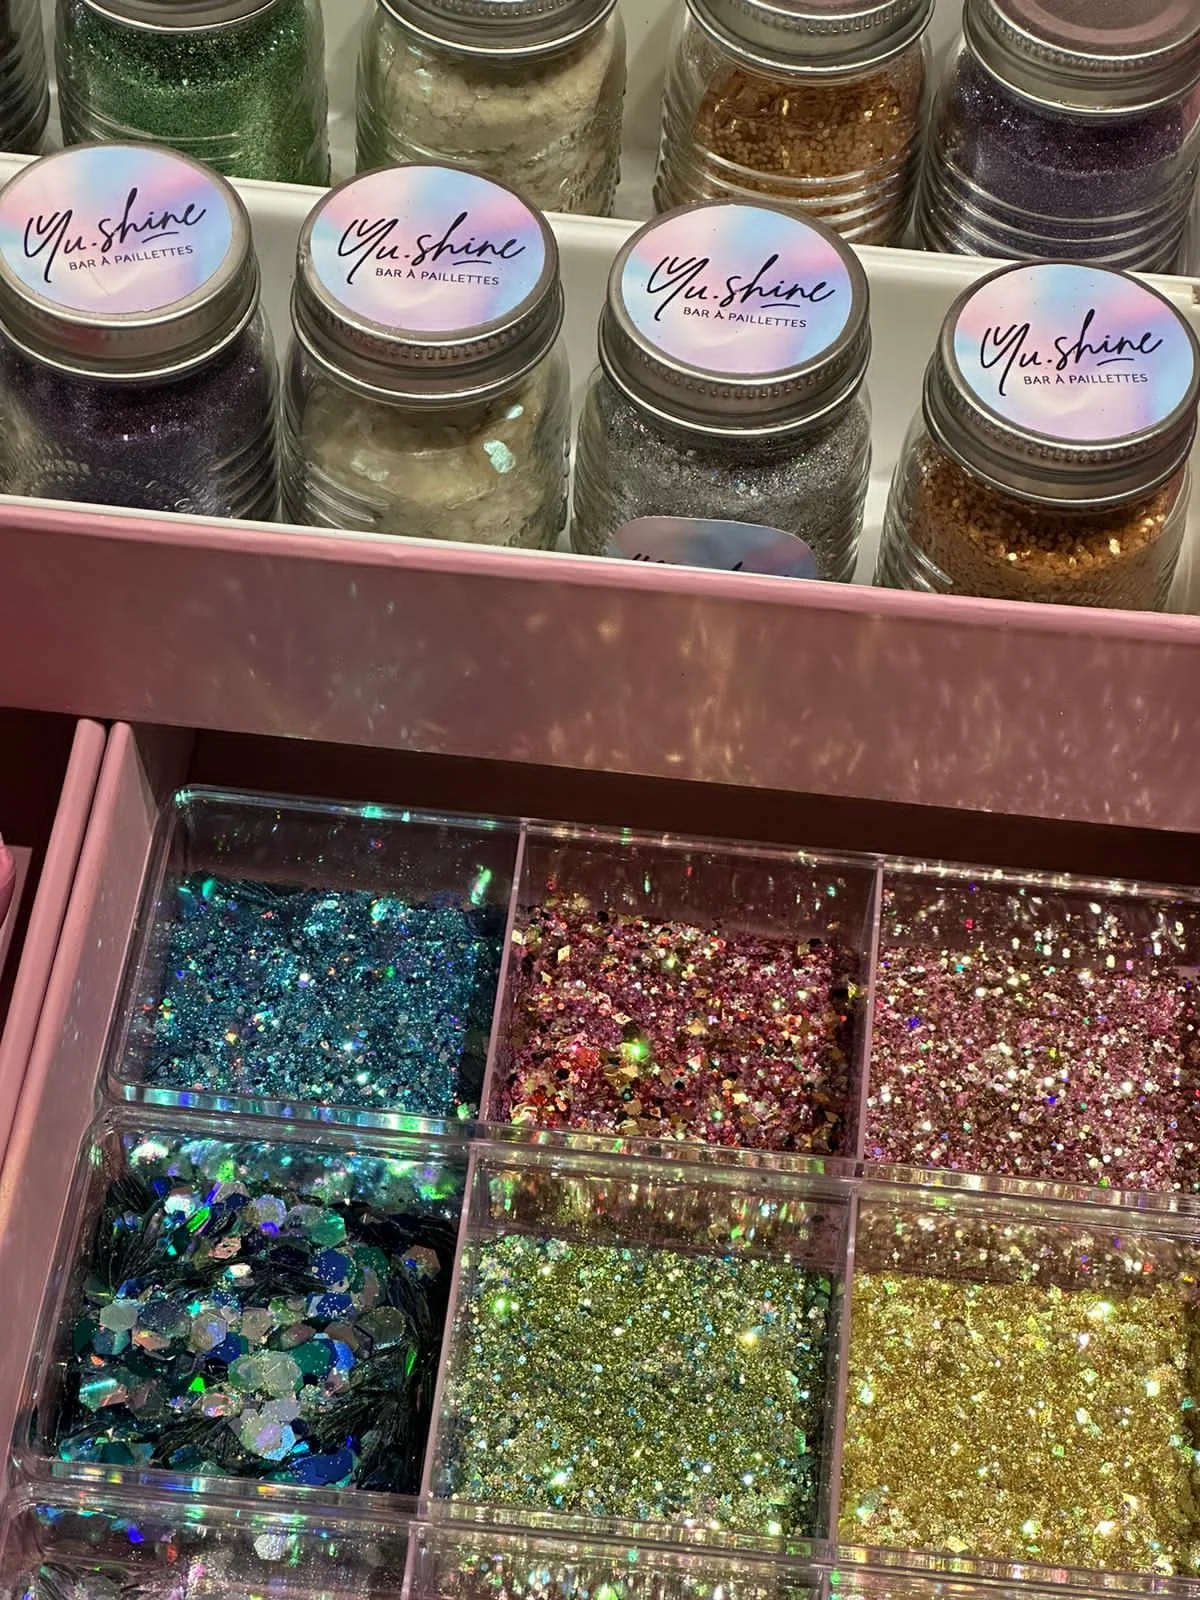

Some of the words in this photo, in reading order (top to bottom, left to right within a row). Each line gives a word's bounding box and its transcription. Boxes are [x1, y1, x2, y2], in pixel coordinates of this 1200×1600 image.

[69, 260, 97, 271] BAR
[101, 252, 111, 266] À
[114, 244, 194, 265] PAILLETTES
[375, 267, 402, 278] BAR
[406, 267, 416, 280] À
[421, 272, 500, 285] PAILLETTES
[683, 306, 709, 319] BAR
[714, 307, 725, 321] À
[728, 312, 807, 328] PAILLETTES
[1024, 375, 1050, 385] BAR
[1055, 373, 1065, 385] À
[1069, 373, 1148, 384] PAILLETTES
